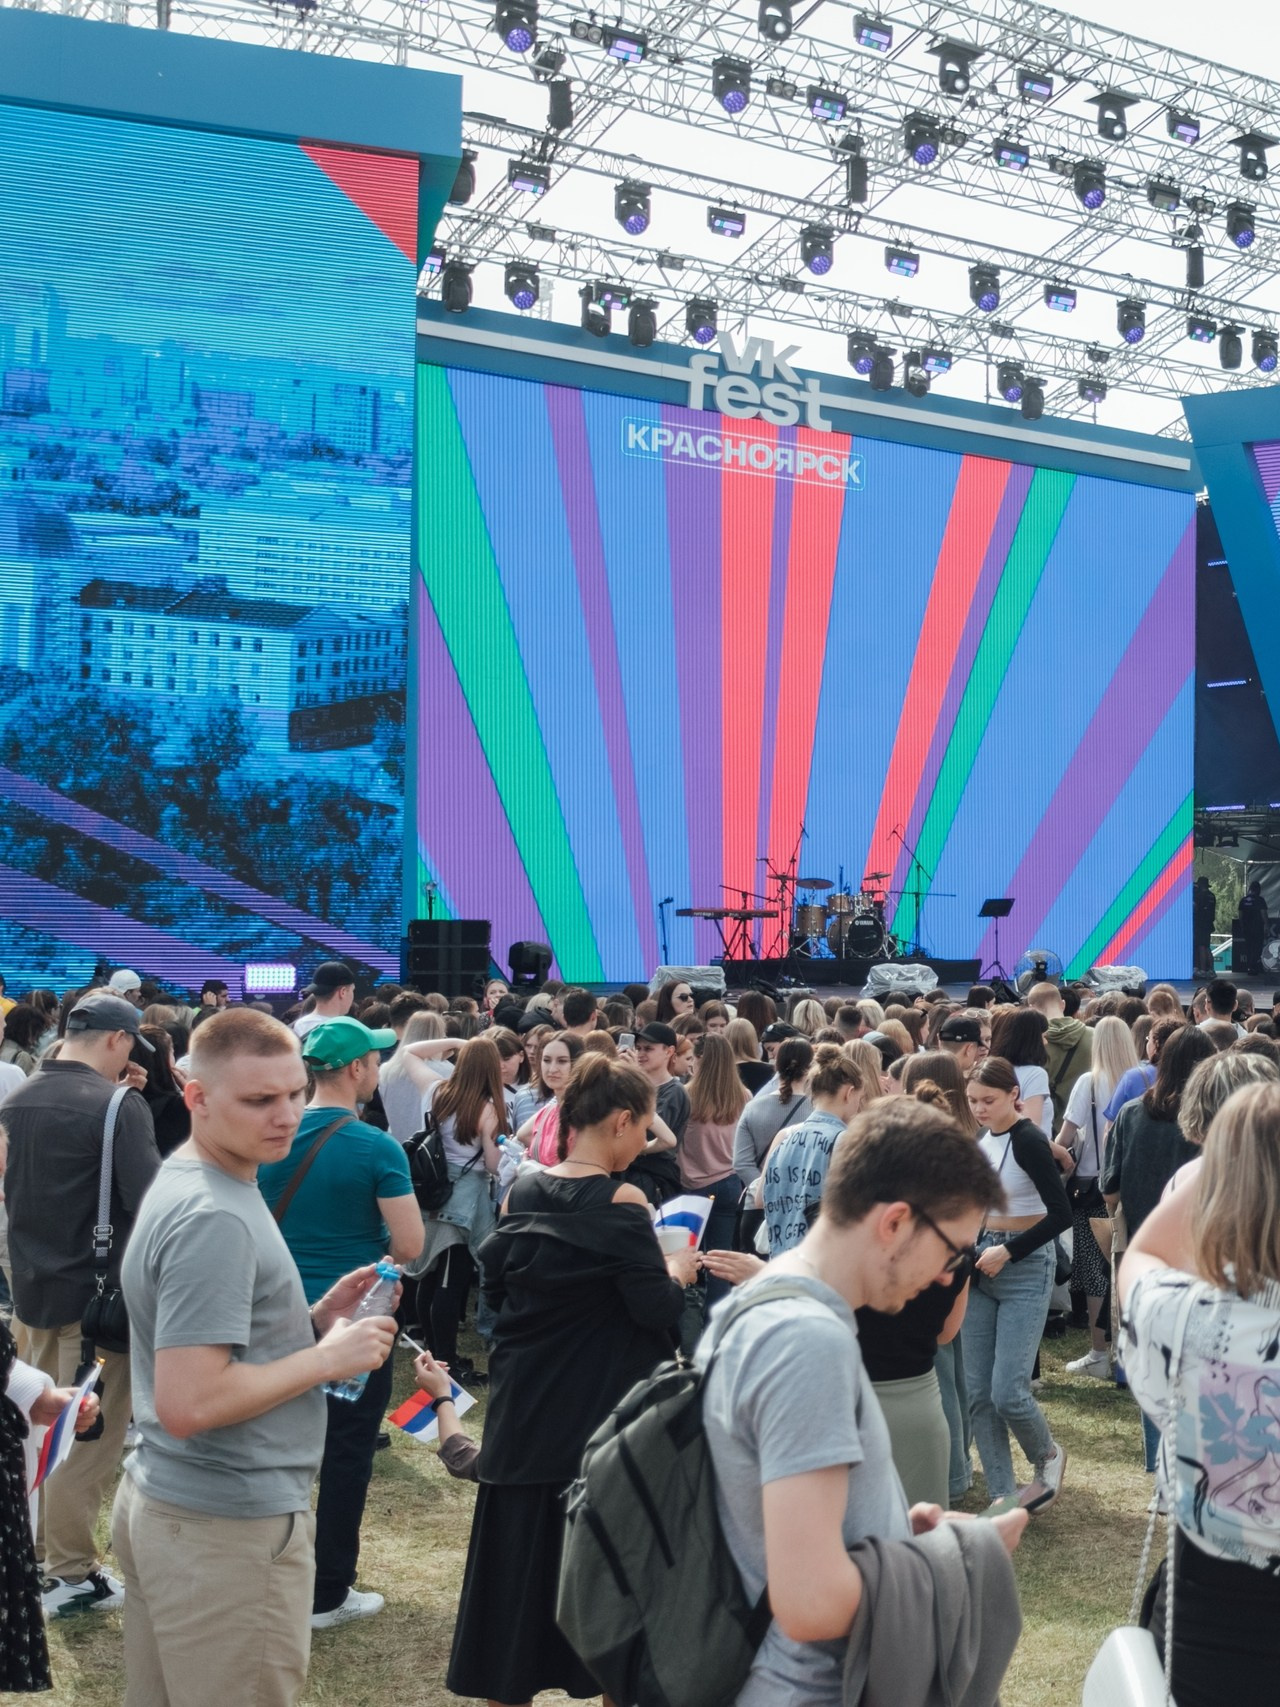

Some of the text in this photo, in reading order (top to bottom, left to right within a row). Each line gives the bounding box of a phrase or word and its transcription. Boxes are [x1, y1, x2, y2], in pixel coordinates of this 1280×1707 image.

[717, 331, 802, 385] VK
[688, 354, 831, 432] fest
[627, 423, 861, 484] КРАСНОЯРСК
